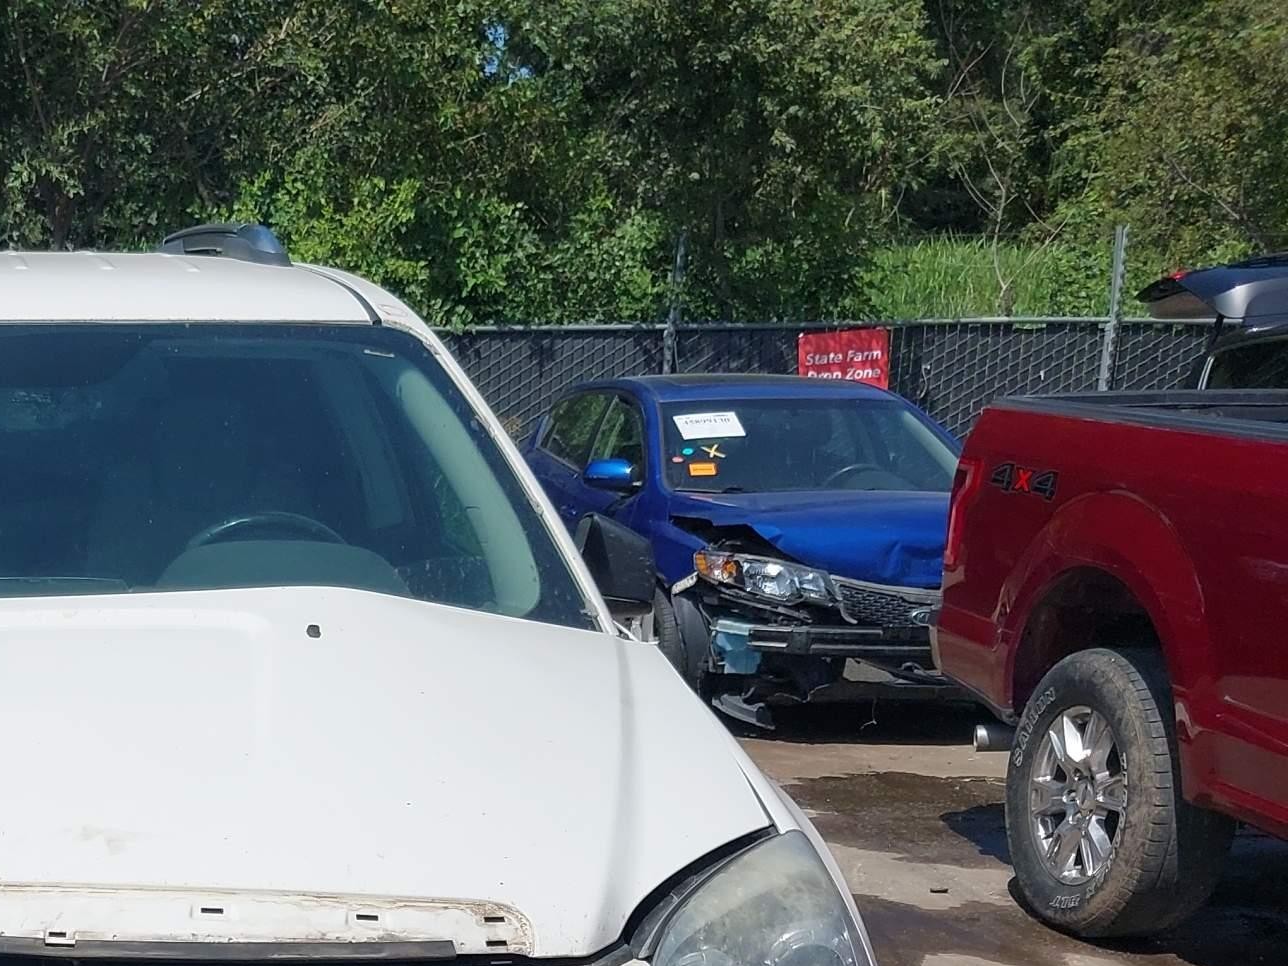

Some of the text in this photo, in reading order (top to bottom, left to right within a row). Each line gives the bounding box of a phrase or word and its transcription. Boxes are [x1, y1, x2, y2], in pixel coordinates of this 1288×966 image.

[805, 349, 882, 366] State Farm
[845, 367, 881, 380] Zone
[1013, 686, 1057, 767] SAILUN
